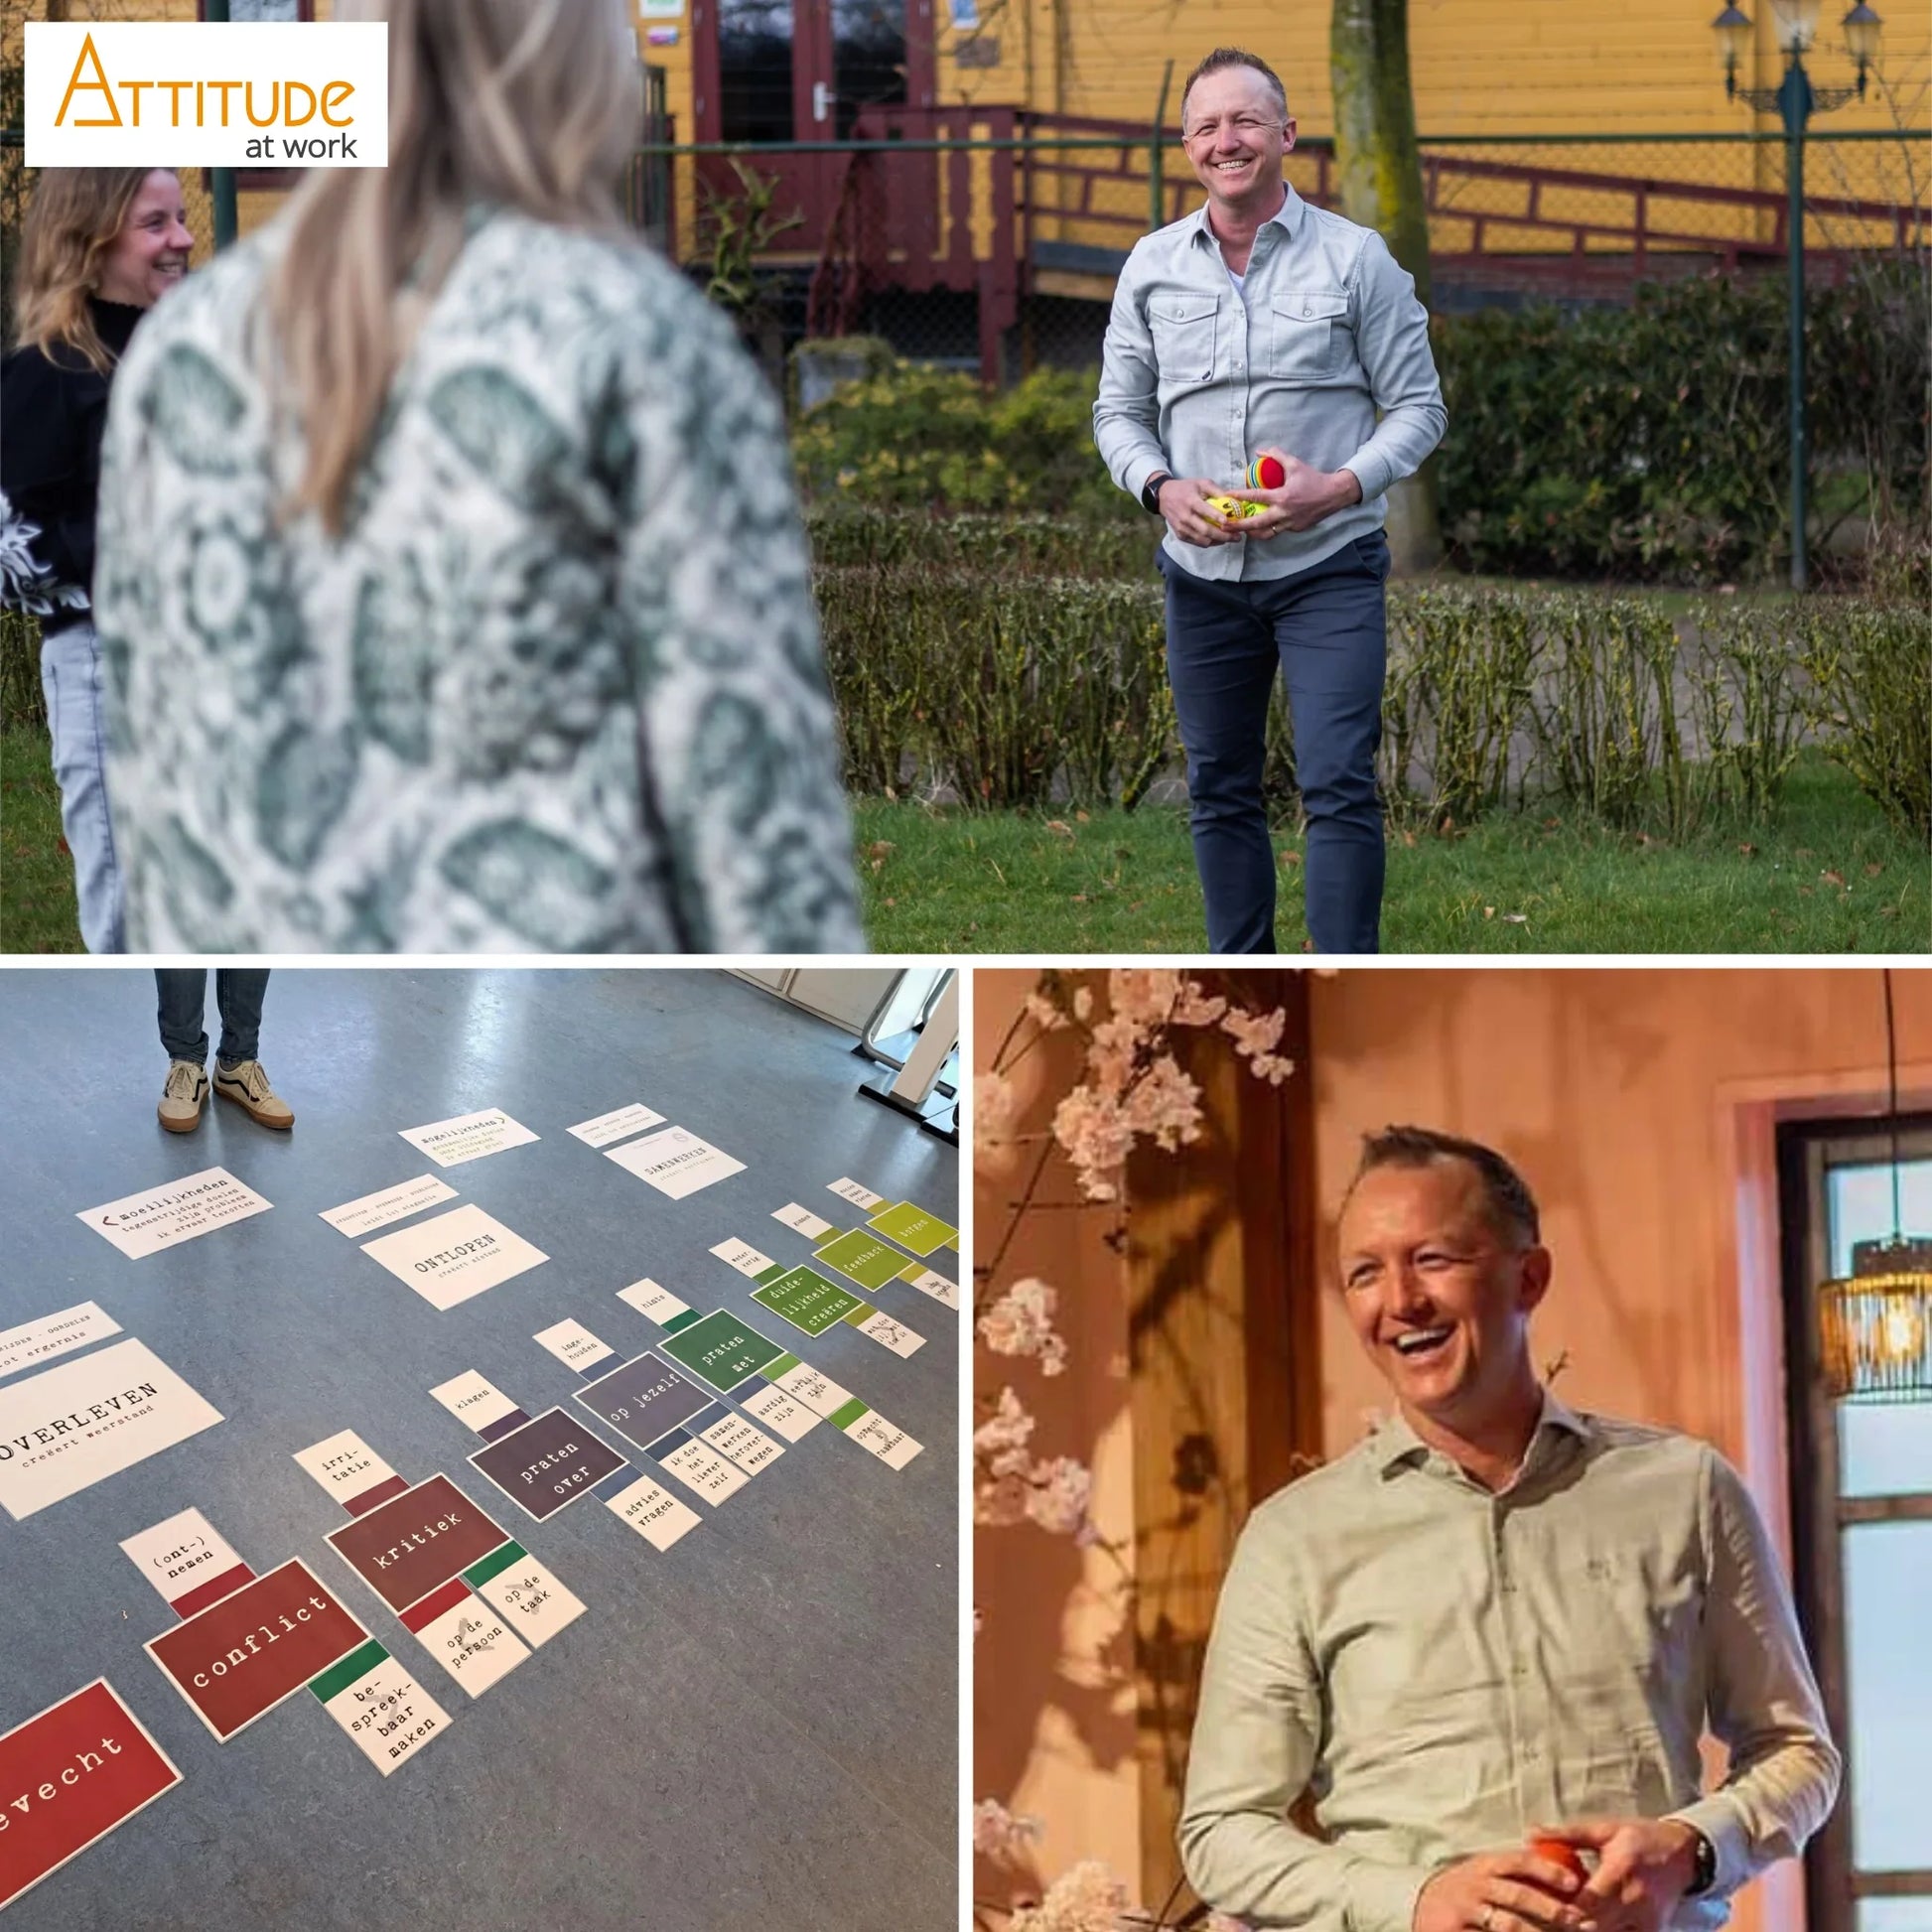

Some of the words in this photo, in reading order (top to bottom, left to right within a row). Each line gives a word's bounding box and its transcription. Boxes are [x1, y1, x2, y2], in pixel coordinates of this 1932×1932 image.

[119, 1178, 228, 1221] moeilijkheden
[122, 1201, 203, 1233] tegenstrijdige
[207, 1188, 239, 1203] doelen
[178, 1210, 201, 1223] zijn
[207, 1195, 247, 1214] probleem
[175, 1218, 207, 1233] ervaar
[213, 1200, 255, 1218] tekorten
[898, 1219, 928, 1238] borgen
[414, 1234, 496, 1273] ONTLOPEN
[843, 1246, 885, 1272] feedback
[769, 1277, 803, 1300] duide-
[781, 1284, 830, 1315] lijkheid
[641, 1294, 666, 1310] hints
[808, 1299, 849, 1326] creëren
[48, 1314, 91, 1334] OORDELEN
[27, 1331, 85, 1357] ergernis
[561, 1337, 584, 1351] inge-
[568, 1342, 598, 1360] houden
[702, 1335, 745, 1366] praten
[731, 1355, 756, 1373] met
[455, 1388, 490, 1410] klagen
[610, 1406, 630, 1423] op
[633, 1373, 680, 1409] jezelf
[759, 1395, 787, 1417] aardig
[774, 1407, 794, 1422] zijn
[22, 1440, 78, 1468] creëert
[87, 1405, 154, 1438] weerstand
[709, 1419, 737, 1441] samen-
[722, 1427, 752, 1449] werken
[322, 1449, 359, 1471] irri-
[671, 1456, 683, 1466] ik
[684, 1446, 700, 1456] doe
[730, 1434, 764, 1460] herover-
[749, 1446, 773, 1465] wegen
[333, 1459, 371, 1482] tatie
[520, 1442, 579, 1483] praten
[687, 1458, 704, 1470] het
[692, 1461, 721, 1483] liever
[554, 1465, 590, 1494] over
[709, 1472, 729, 1489] zelf
[624, 1489, 660, 1517] advies
[638, 1498, 674, 1528] vragen
[153, 1536, 206, 1568] (ont-)
[372, 1512, 463, 1570] kritiek
[168, 1550, 214, 1579] nemen
[505, 1588, 521, 1604] op
[523, 1574, 541, 1588] de
[520, 1589, 551, 1613] taak
[193, 1595, 327, 1689] conflict
[447, 1633, 464, 1649] op
[467, 1618, 483, 1633] de
[452, 1626, 502, 1670] persoon
[353, 1680, 381, 1703] be-
[351, 1683, 412, 1732] spreek-
[377, 1704, 415, 1737] baar
[388, 1718, 437, 1759] maken
